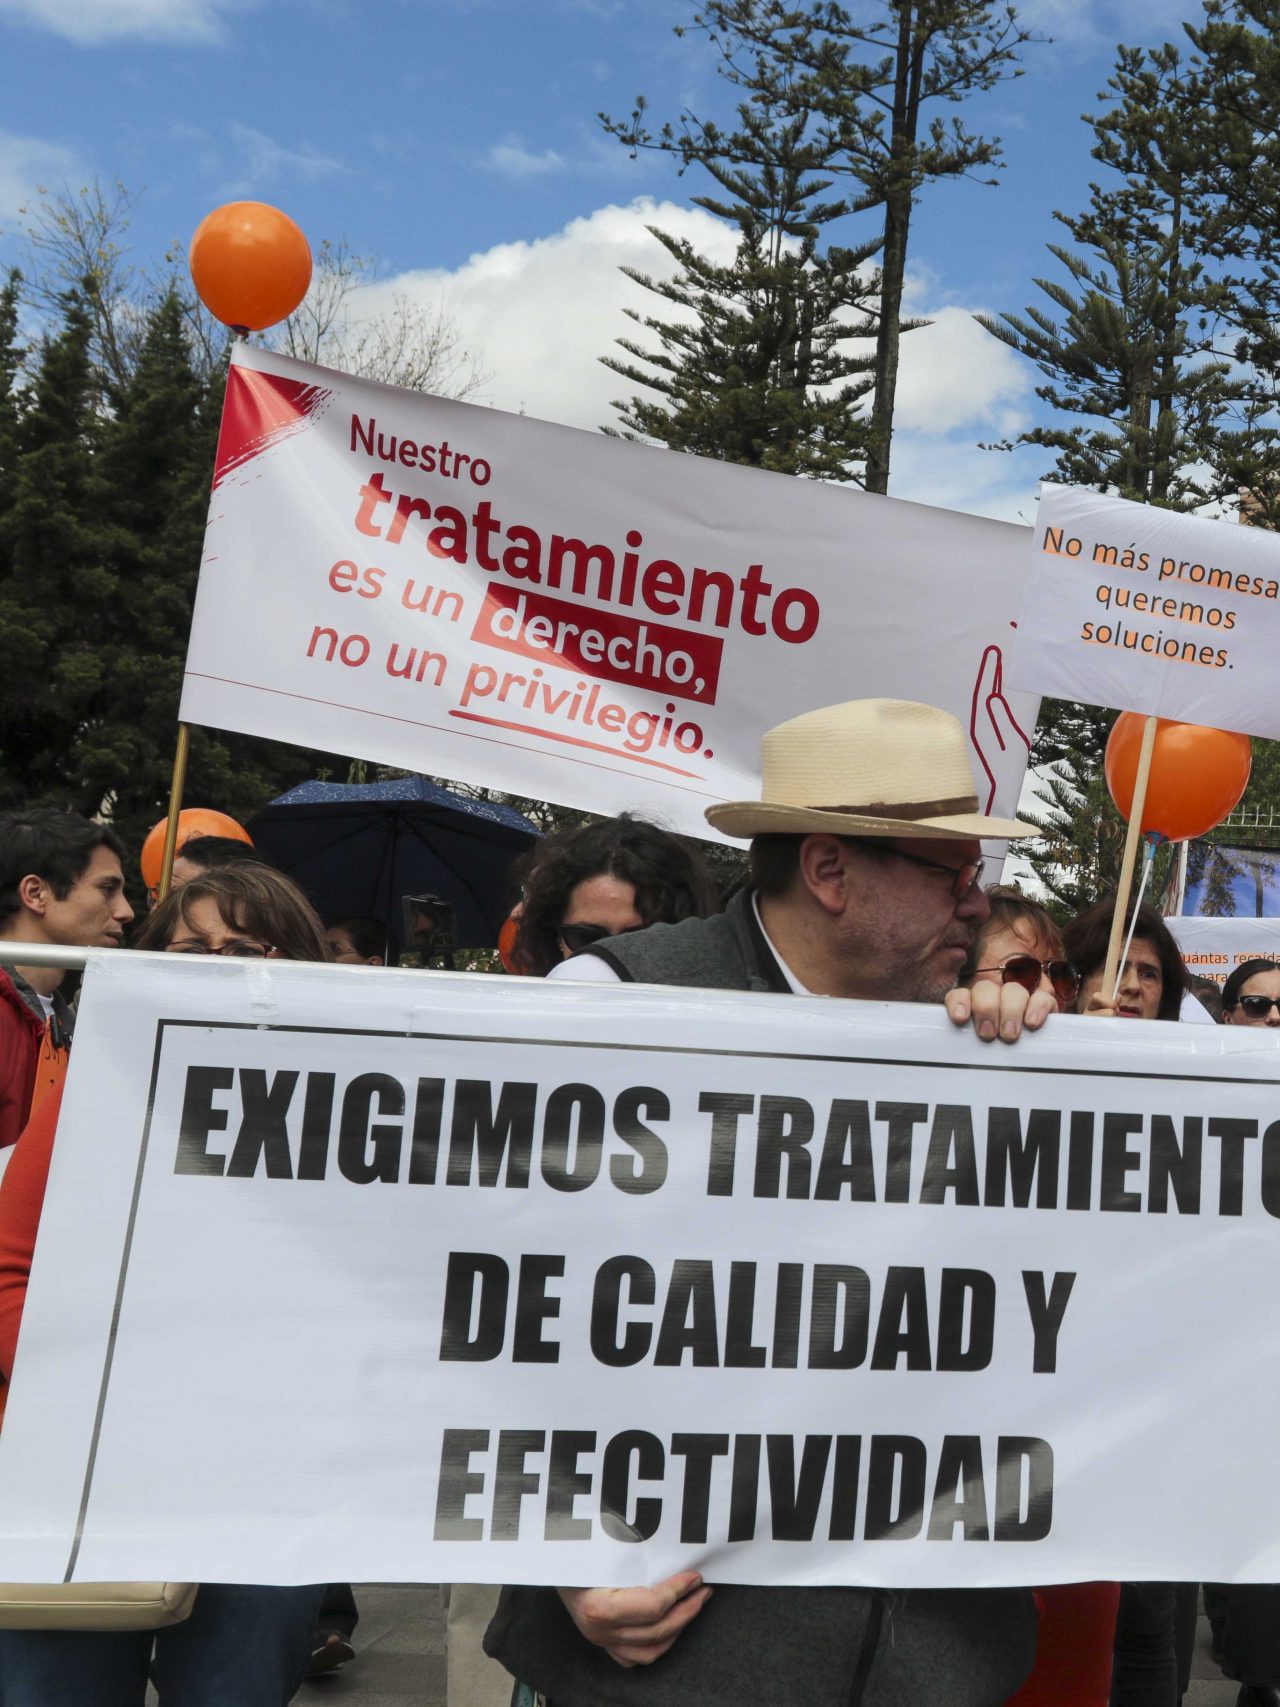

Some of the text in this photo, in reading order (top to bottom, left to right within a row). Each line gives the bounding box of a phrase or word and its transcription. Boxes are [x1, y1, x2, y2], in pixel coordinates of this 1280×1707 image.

[349, 413, 492, 486] Nuestro
[353, 471, 821, 644] tratamiento
[1042, 526, 1083, 557] No
[1092, 542, 1150, 572] más
[1095, 582, 1237, 630] queremos
[328, 559, 707, 697] es un derecho,
[1081, 620, 1235, 670] soluciones.
[306, 625, 714, 761] no un privilegio.
[175, 1065, 669, 1195] EXIGIMOS
[439, 1252, 1077, 1374] DE CALIDAD Y
[433, 1429, 1054, 1543] EFECTIVIDAD
